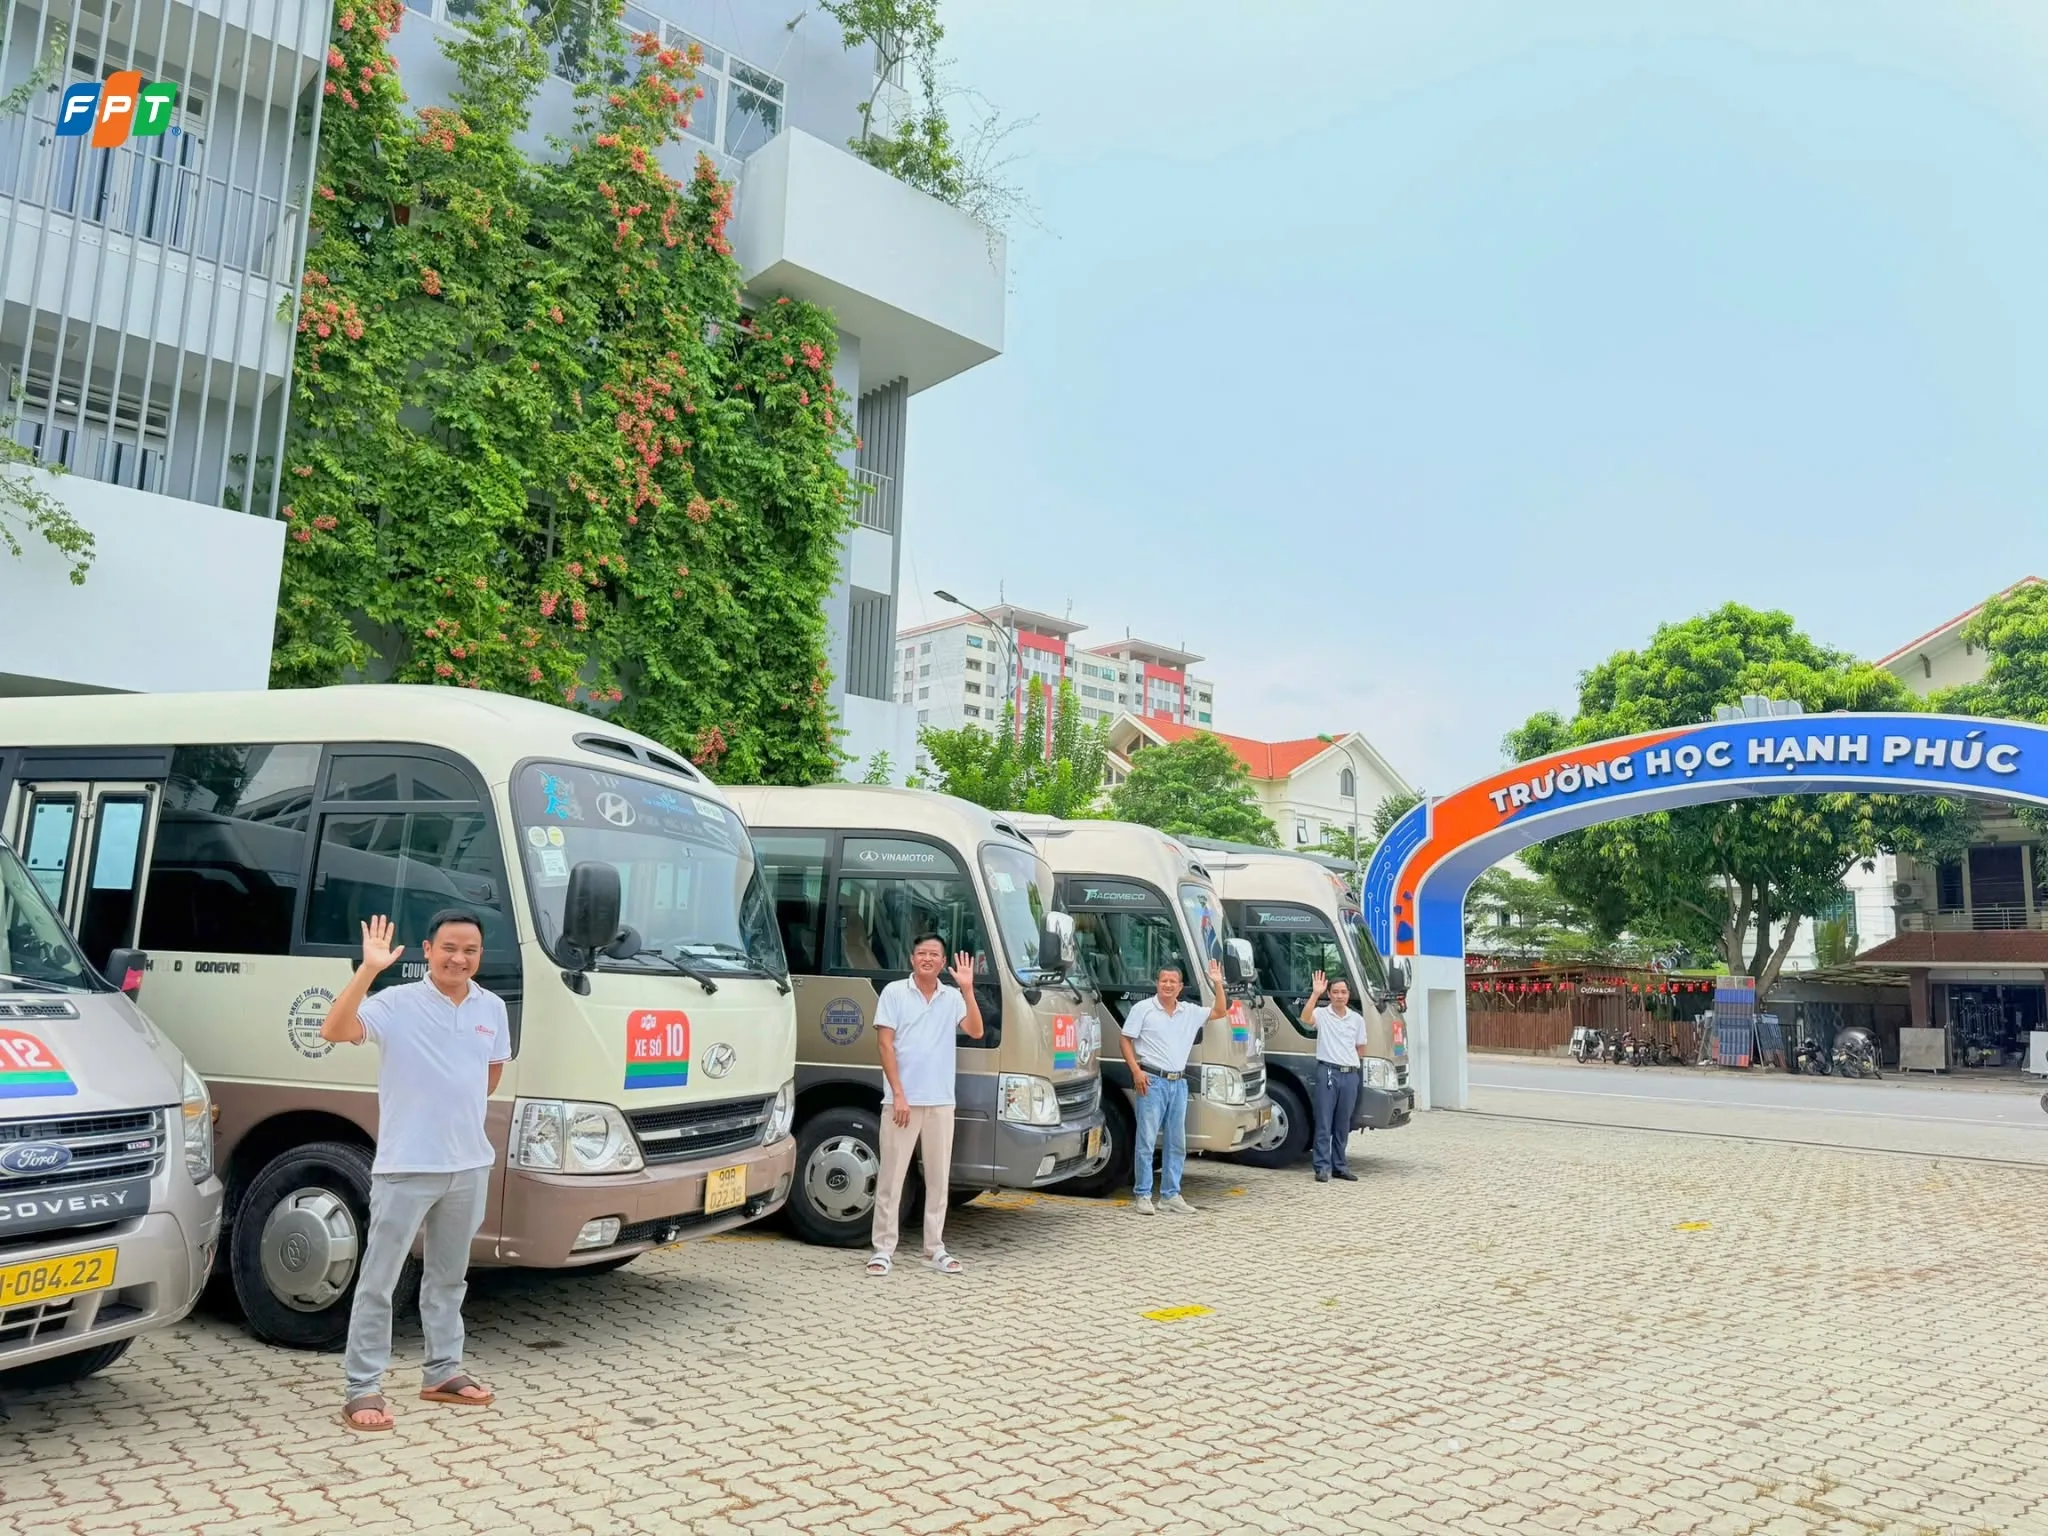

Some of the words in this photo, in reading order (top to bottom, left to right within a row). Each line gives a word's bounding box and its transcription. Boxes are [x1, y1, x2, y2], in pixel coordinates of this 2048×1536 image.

[1489, 756, 1634, 813] TRƯỜNG
[1646, 741, 1733, 778] HỌC
[1748, 735, 1869, 772] HẠNH
[1882, 730, 2022, 775] PHÚC
[881, 853, 935, 862] VINAMOTOR
[1083, 888, 1146, 903] TRACOMECO
[402, 962, 430, 979] COUN
[634, 1038, 647, 1057] XE
[649, 1032, 662, 1057] SỐ
[665, 1023, 684, 1057] 10
[17, 1148, 58, 1168] Ford
